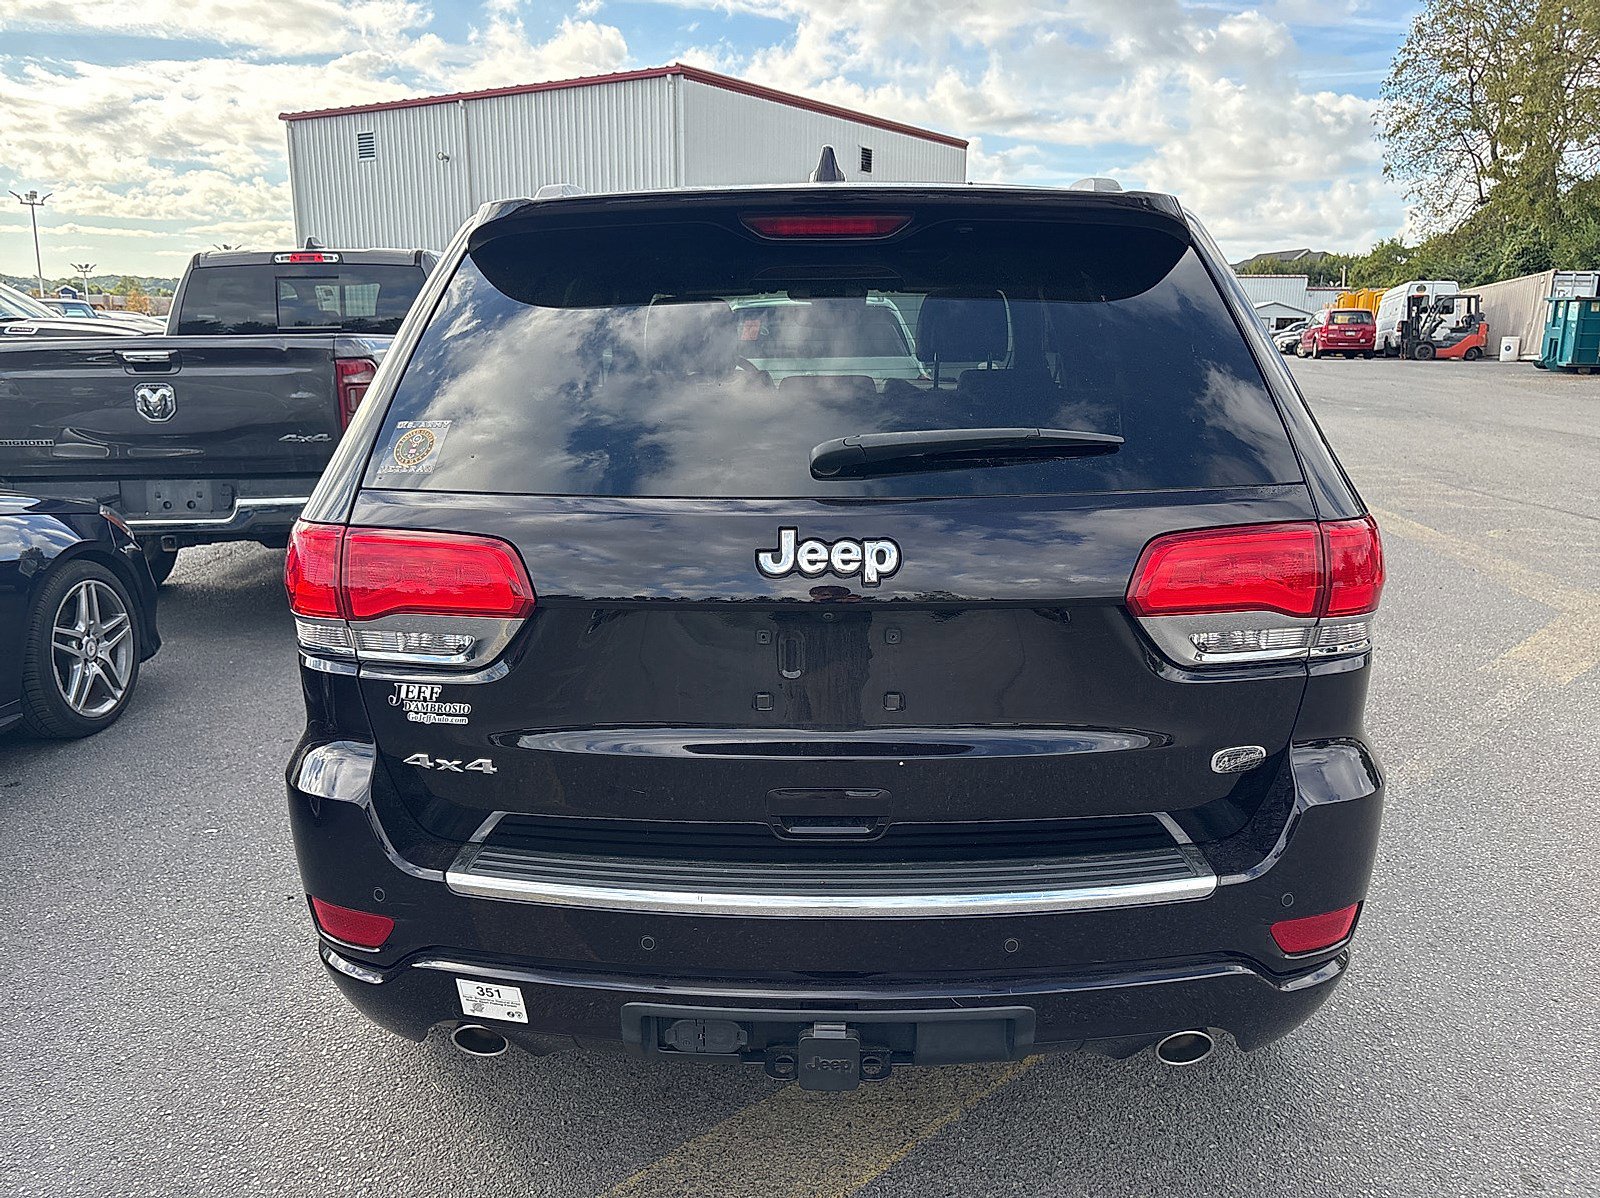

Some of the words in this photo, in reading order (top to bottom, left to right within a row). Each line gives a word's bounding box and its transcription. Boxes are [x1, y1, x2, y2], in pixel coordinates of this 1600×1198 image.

[278, 433, 332, 443] 4x4
[757, 527, 900, 585] Jeep
[387, 682, 442, 706] JEFF
[402, 700, 472, 715] D'AMBROSIO
[407, 712, 469, 725] GoJeffAuto.com
[402, 753, 499, 775] 4x4
[476, 986, 501, 999] 351
[805, 1055, 855, 1074] Jeep
